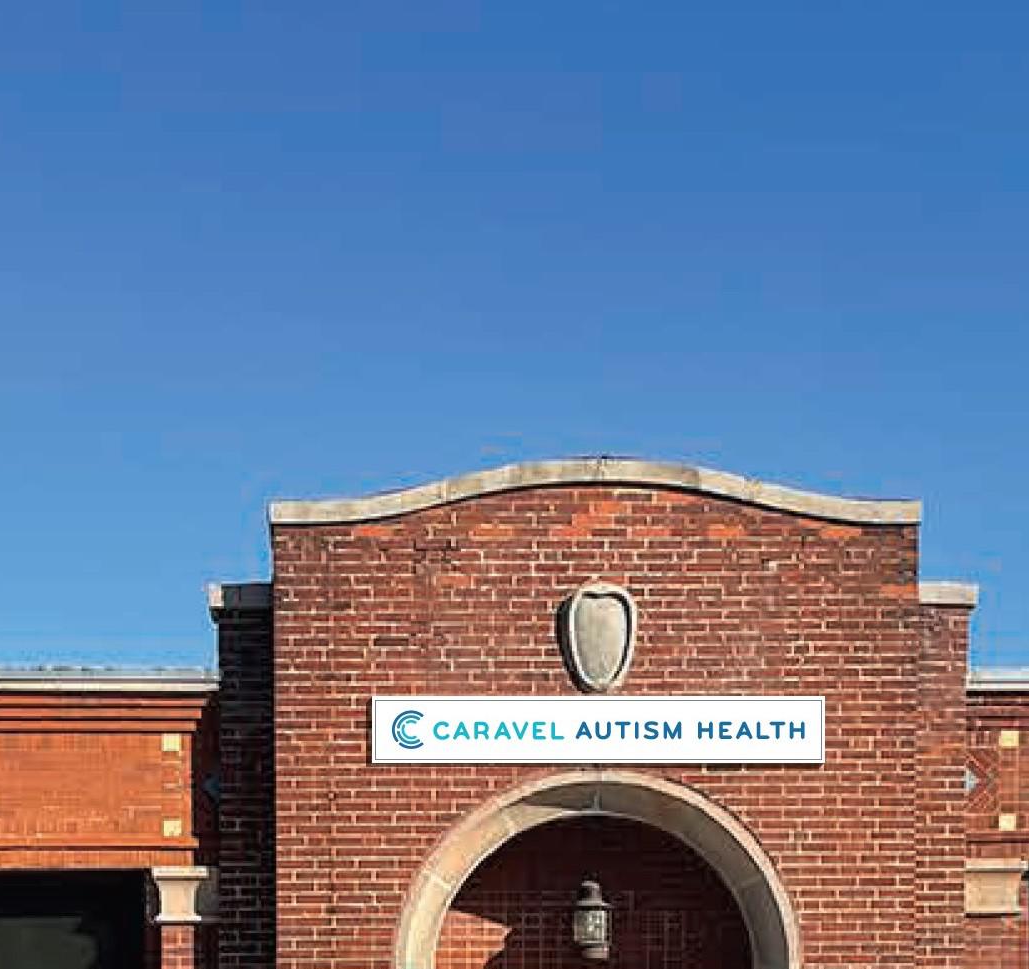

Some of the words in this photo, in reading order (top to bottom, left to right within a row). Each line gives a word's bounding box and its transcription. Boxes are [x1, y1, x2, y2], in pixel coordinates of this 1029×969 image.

[432, 720, 565, 741] CARAVEL
[575, 720, 682, 741] AUTISM
[697, 720, 806, 741] HEALTH
